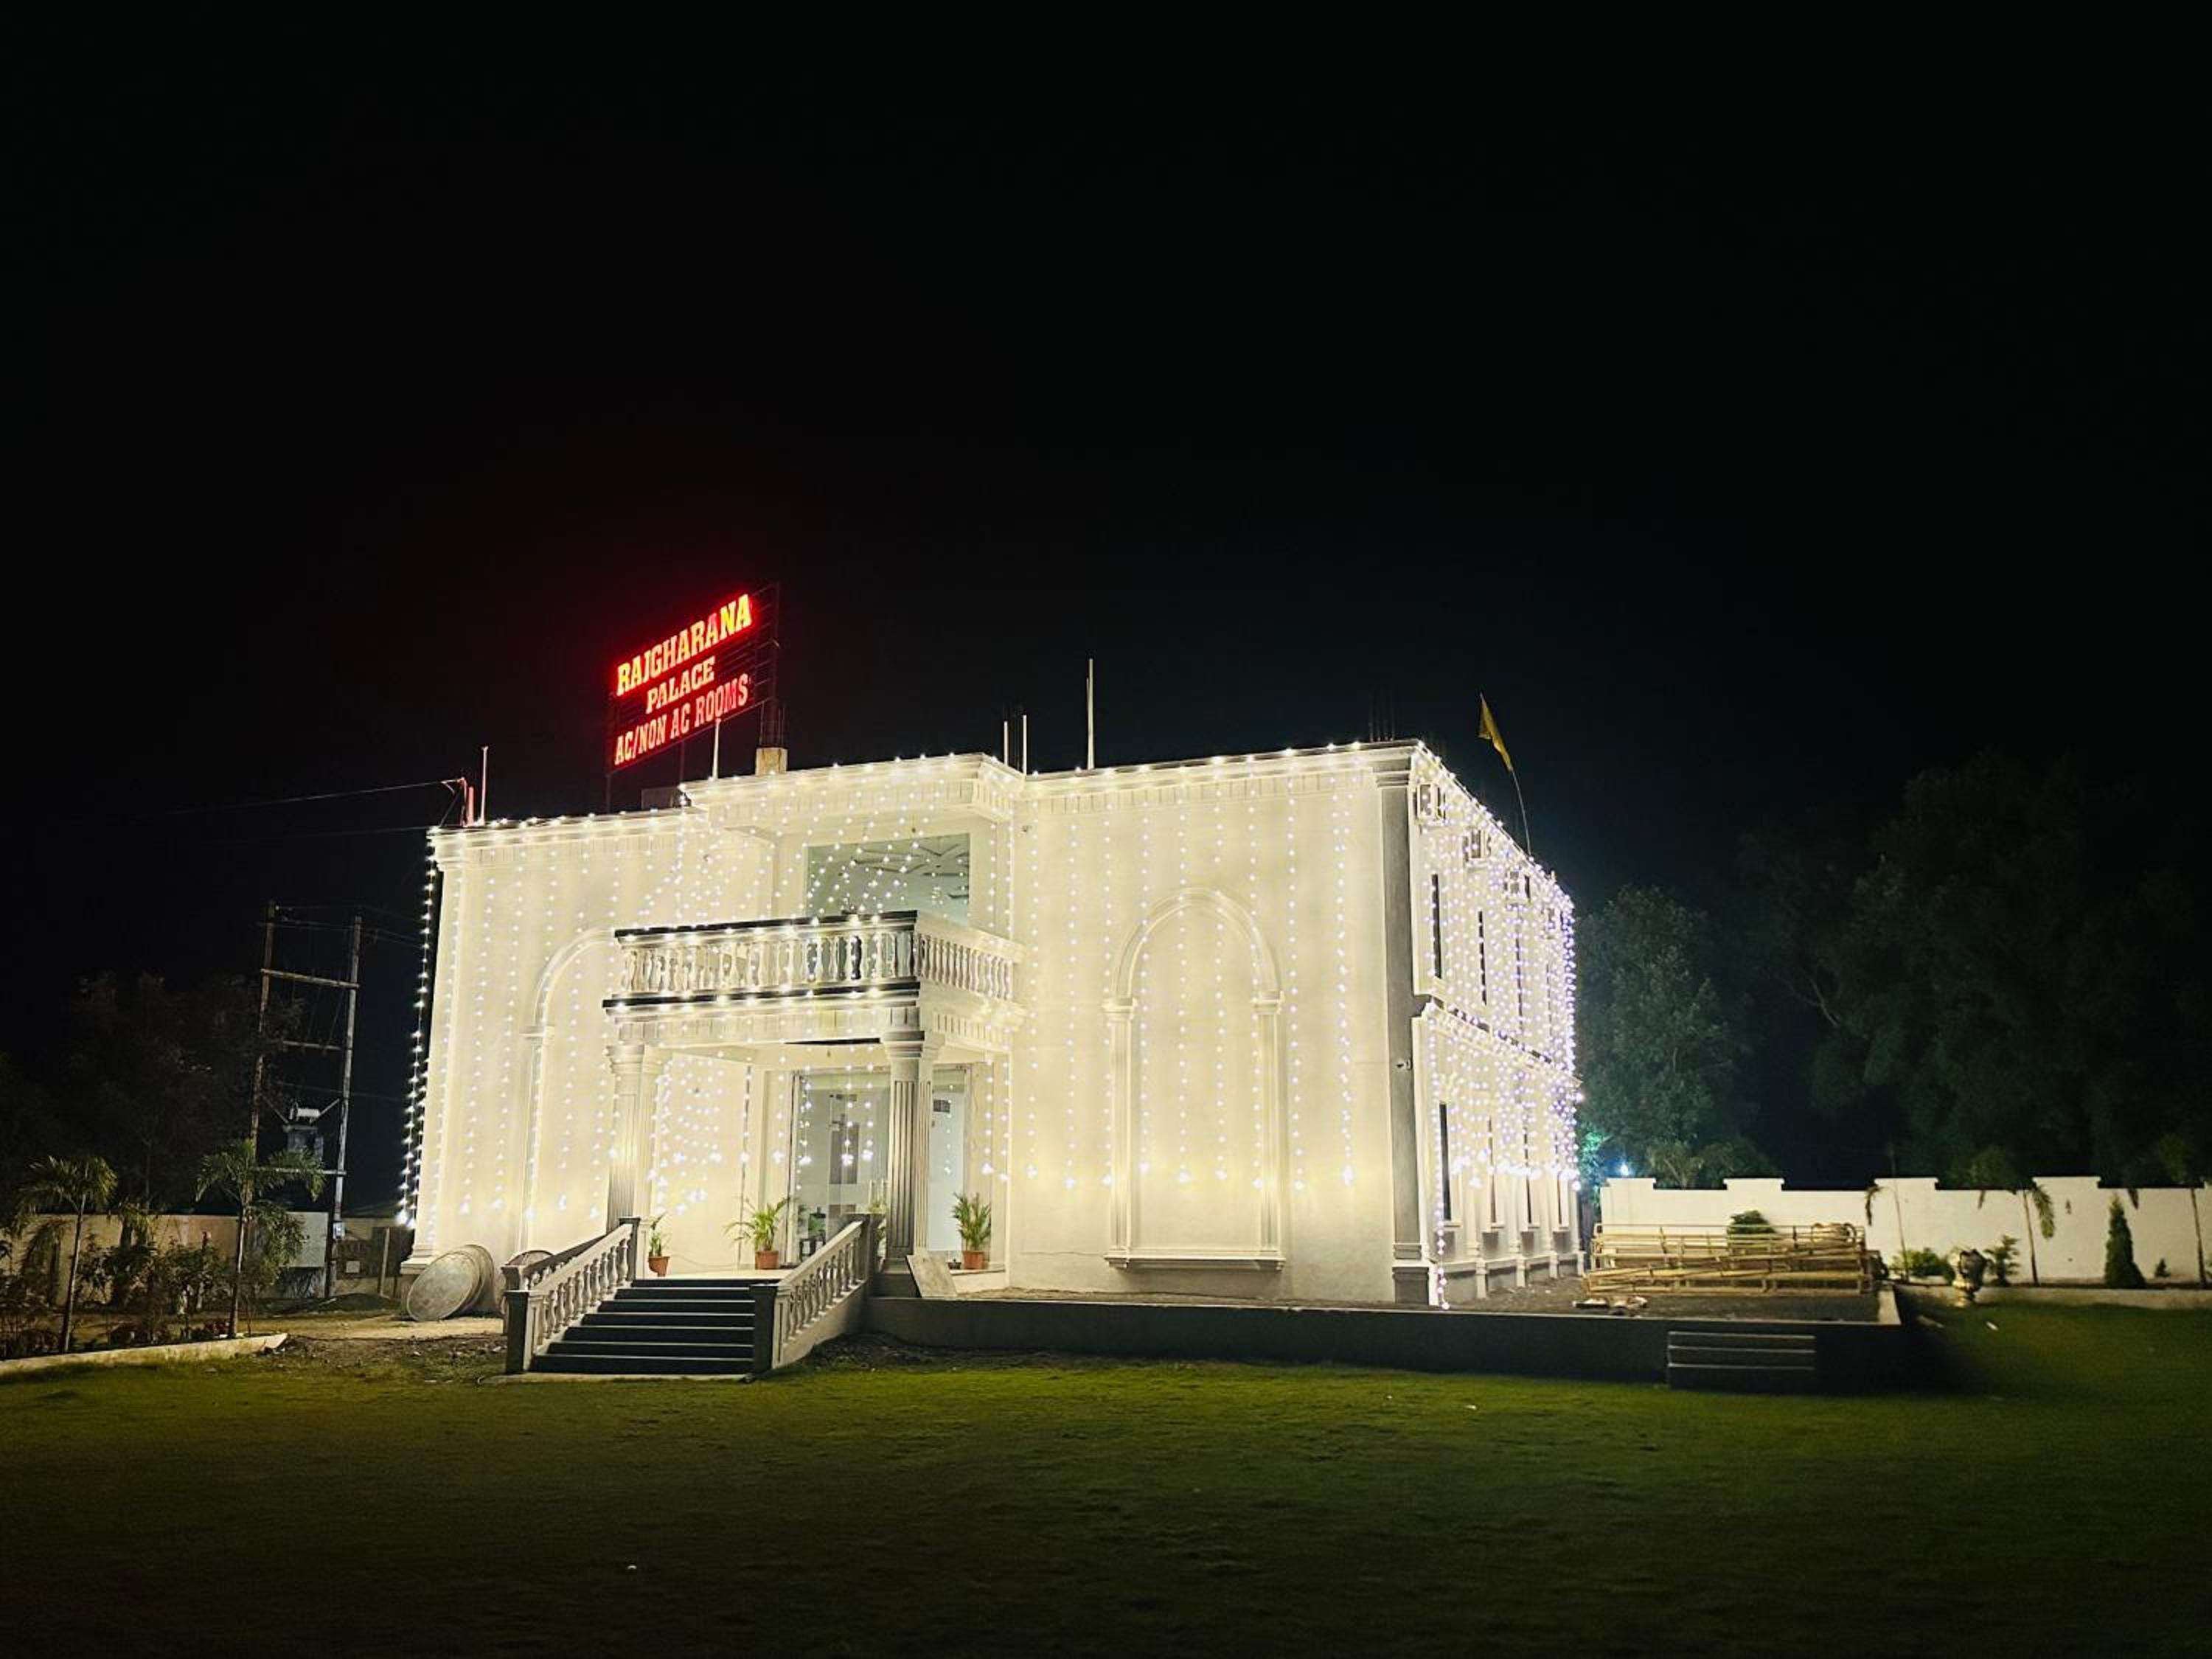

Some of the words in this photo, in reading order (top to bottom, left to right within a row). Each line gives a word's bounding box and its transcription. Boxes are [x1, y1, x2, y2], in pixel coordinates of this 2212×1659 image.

[616, 594, 752, 696] RAJGHARANA
[645, 655, 715, 714] PALACE
[614, 714, 667, 765] AC/NON
[670, 702, 691, 740] AC
[695, 672, 748, 728] ROOMS
